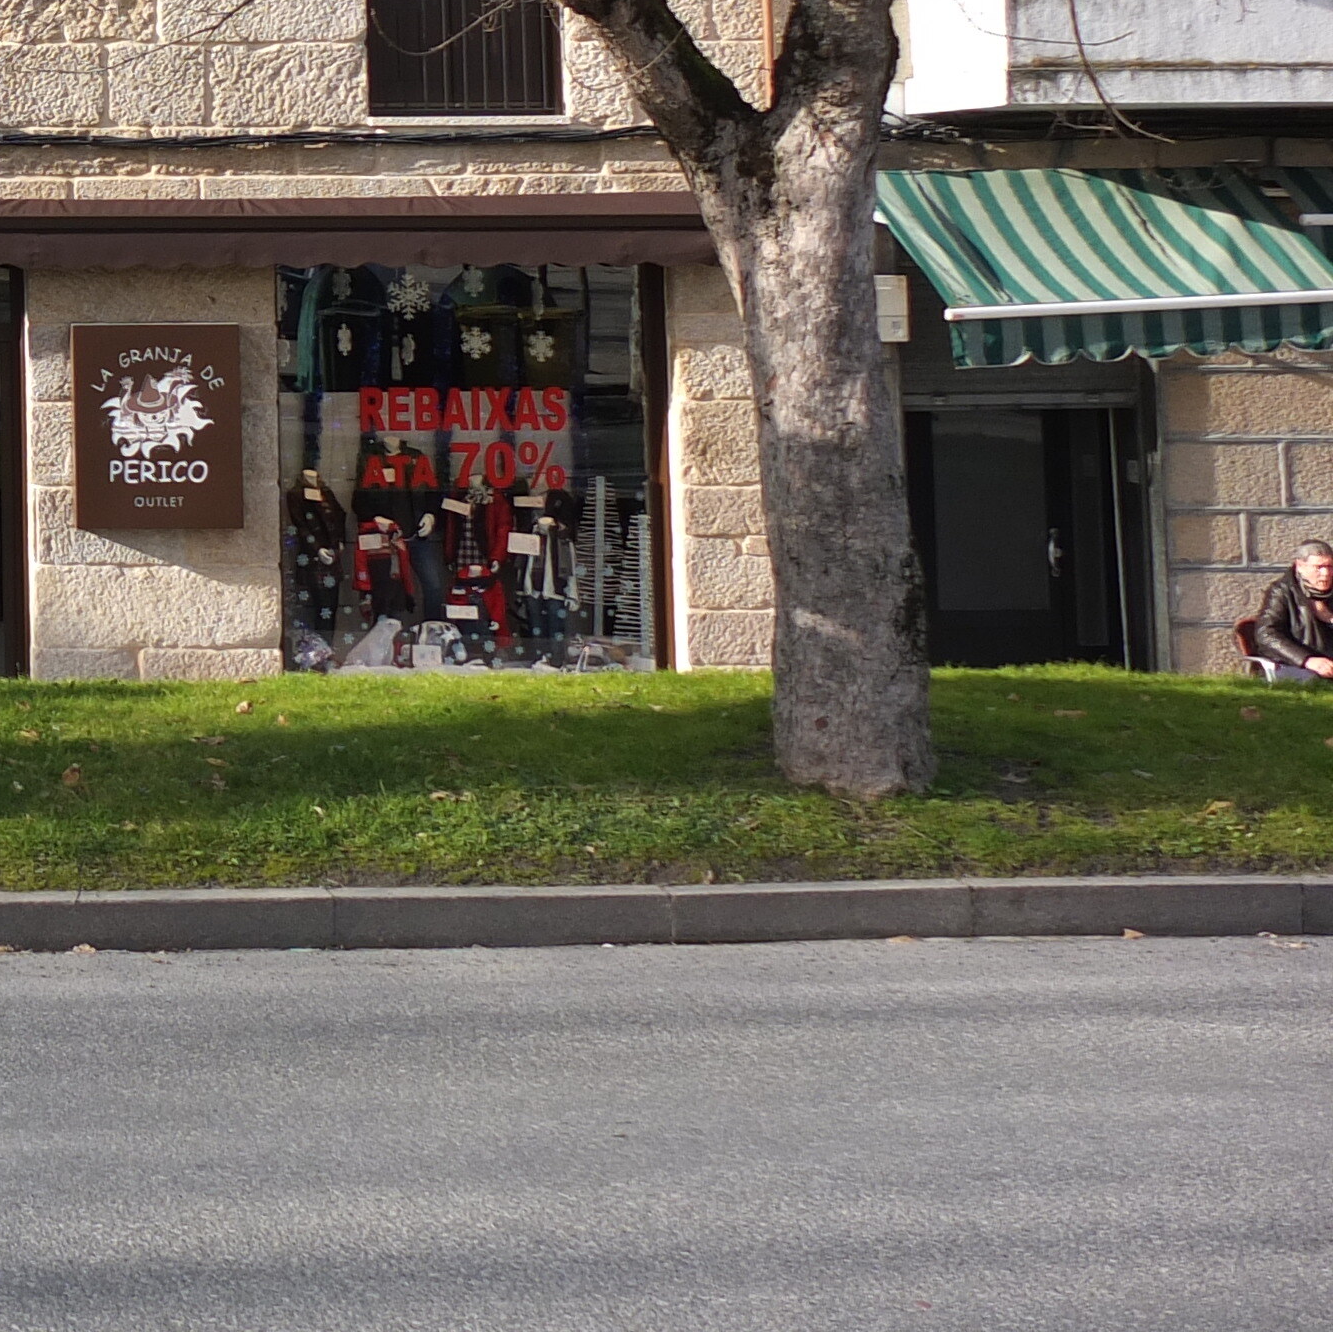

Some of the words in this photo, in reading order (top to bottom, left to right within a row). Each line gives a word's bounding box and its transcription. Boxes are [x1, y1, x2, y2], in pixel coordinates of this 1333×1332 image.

[91, 368, 114, 392] LA
[119, 346, 192, 368] GRANJA
[200, 366, 225, 391] DE
[359, 386, 568, 431] REBAIXAS
[109, 459, 208, 484] PERICO
[363, 454, 437, 488] ATA
[450, 440, 566, 489] 70%
[134, 496, 184, 508] OUTLET
